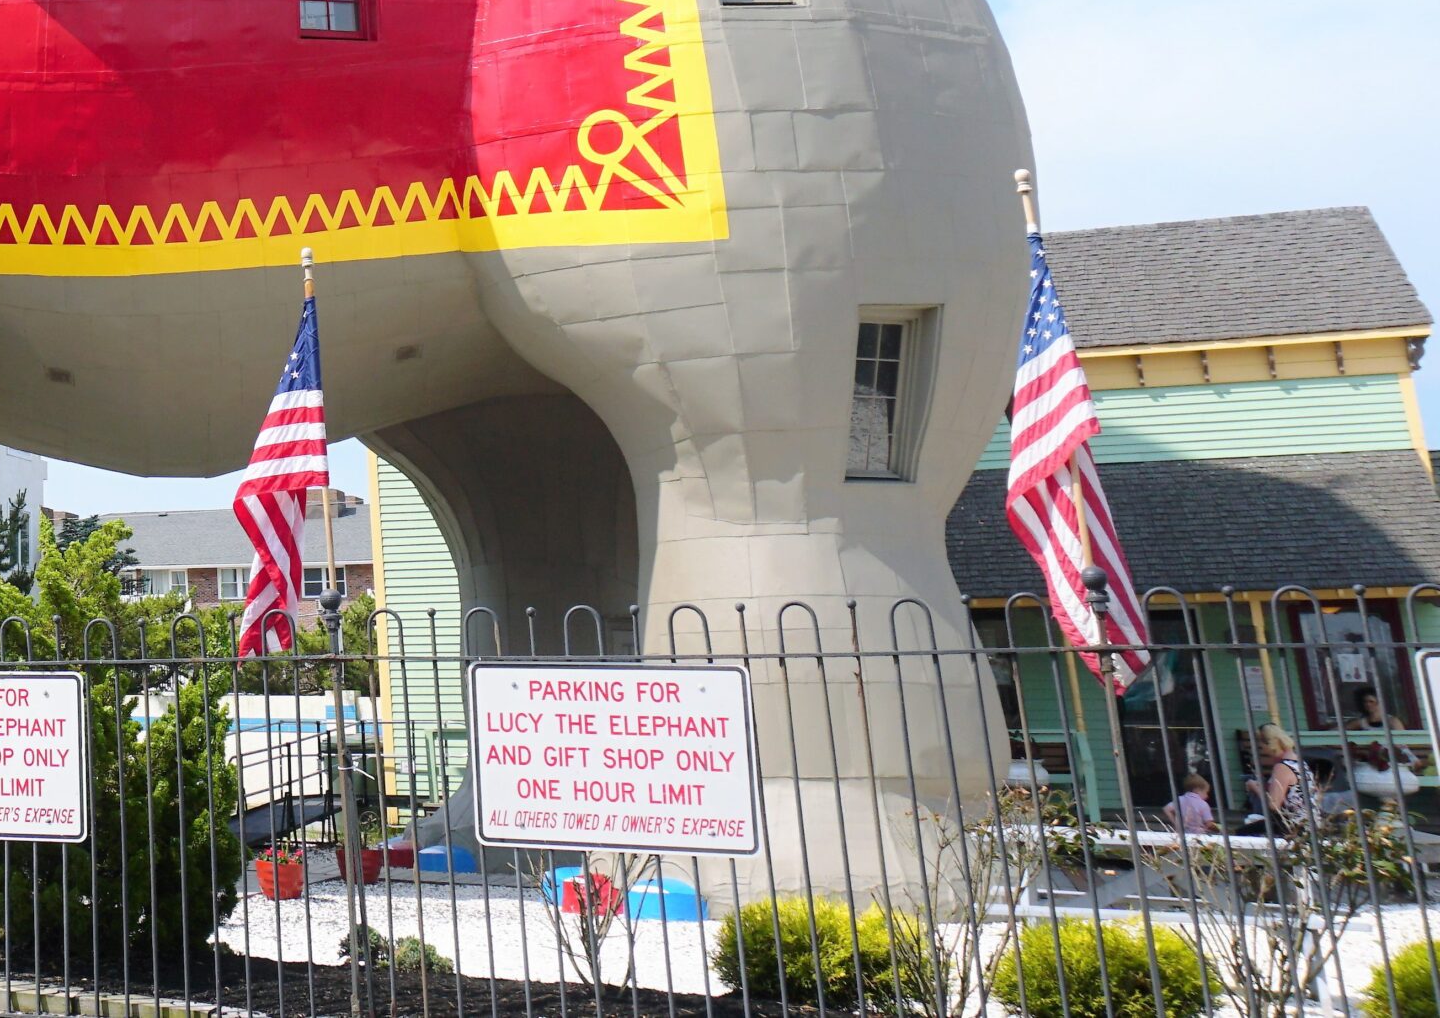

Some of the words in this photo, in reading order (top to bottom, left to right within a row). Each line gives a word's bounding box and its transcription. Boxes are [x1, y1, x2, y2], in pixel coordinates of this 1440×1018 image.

[529, 680, 624, 702] PARKING
[637, 682, 680, 702] FOR
[487, 712, 543, 732] LUCY
[555, 714, 597, 734] THE
[610, 715, 729, 738] ELEPHANT
[24, 749, 69, 767] ONLY
[487, 745, 531, 765] AND
[544, 746, 590, 767] GIFT
[603, 748, 664, 770] SHOP
[676, 750, 734, 772] ONLY
[0, 778, 45, 797] LIMIT
[517, 778, 560, 800] ONE
[574, 781, 635, 802] HOUR
[649, 783, 704, 805] LIMIT
[25, 808, 74, 824] EXPENSE
[490, 810, 509, 826] ALL
[515, 811, 557, 829] OTHERS
[563, 813, 599, 830] TOWED
[604, 814, 617, 831] AT
[622, 815, 674, 834] OWNER'S
[682, 818, 745, 837] EXPENSE
